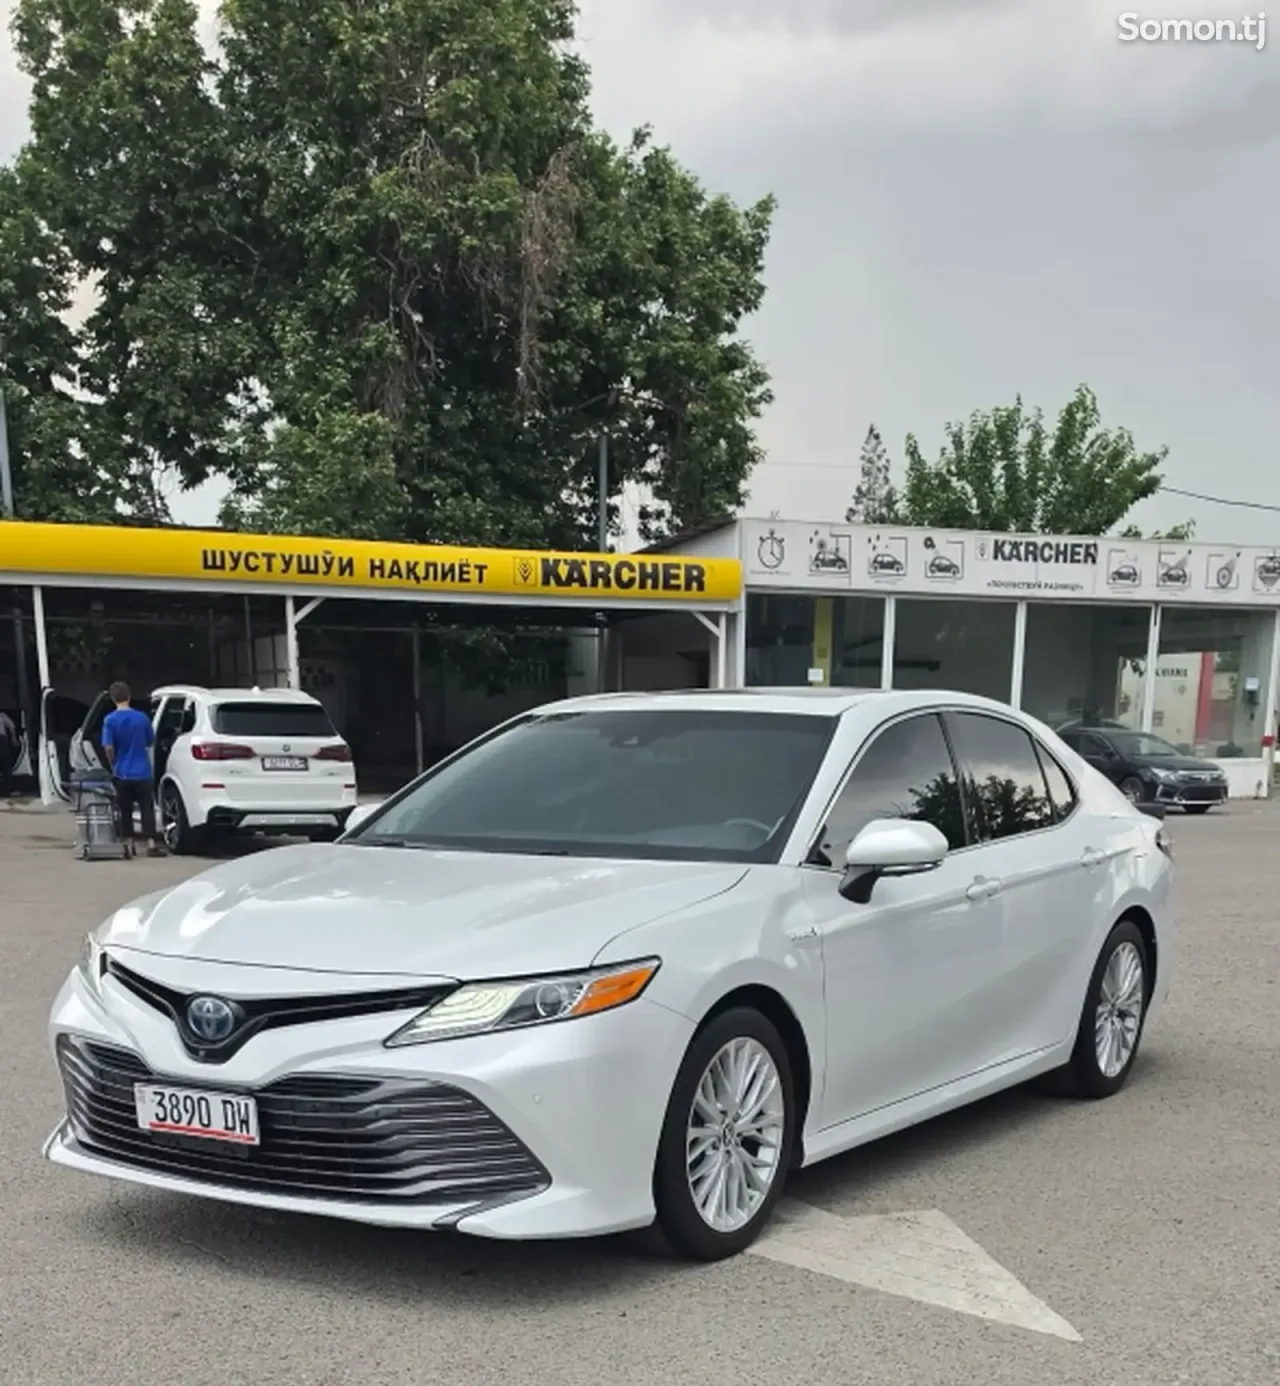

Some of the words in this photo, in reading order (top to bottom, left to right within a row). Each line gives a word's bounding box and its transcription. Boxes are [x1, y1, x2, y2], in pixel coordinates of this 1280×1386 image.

[993, 539, 1098, 565] KÄRCHER
[541, 557, 706, 592] KÄRCHER
[153, 1091, 211, 1128] 3890
